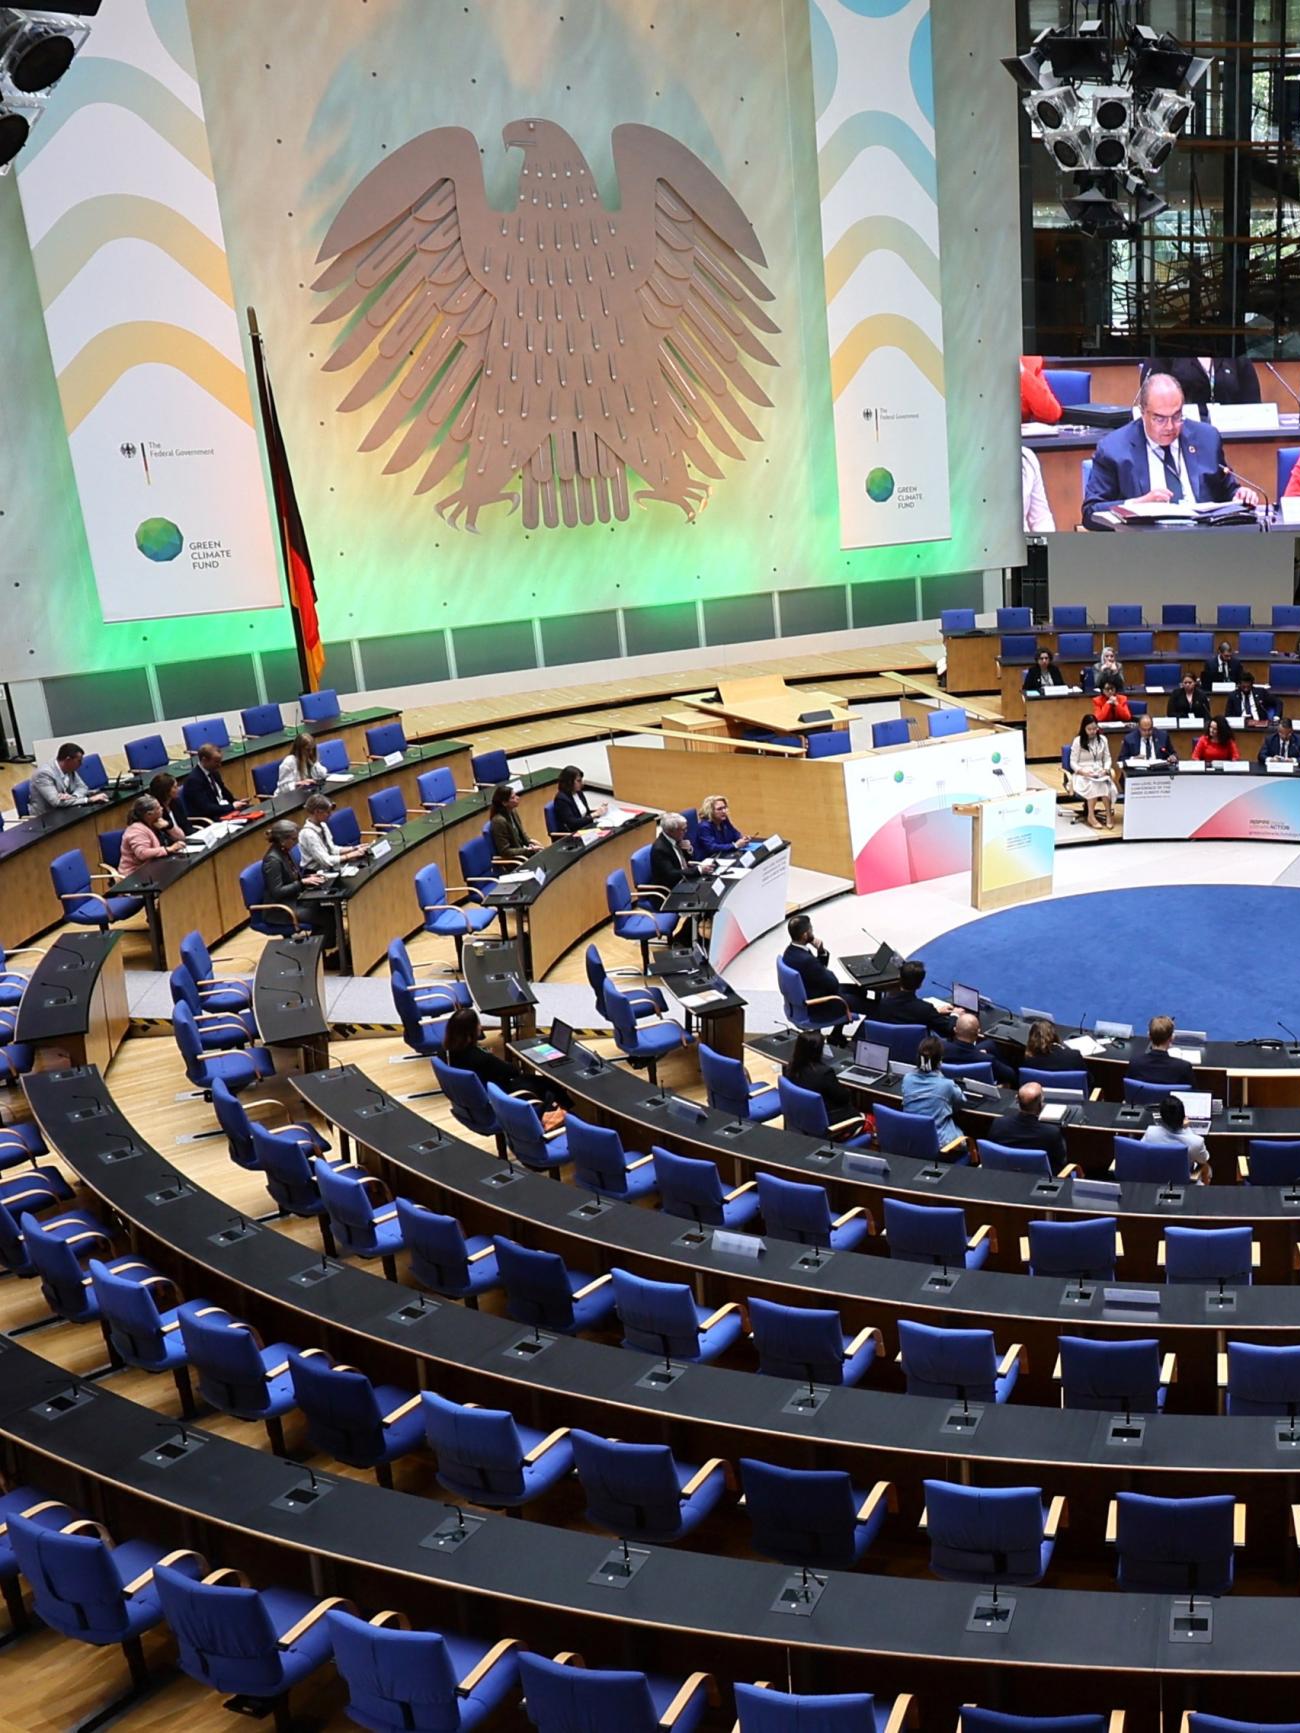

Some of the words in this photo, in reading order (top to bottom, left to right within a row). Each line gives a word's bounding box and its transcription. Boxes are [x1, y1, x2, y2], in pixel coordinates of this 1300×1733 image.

[150, 449, 174, 457] Federal
[175, 448, 214, 457] Government
[897, 486, 917, 494] GREEN
[897, 493, 922, 501] CLIMATE
[189, 541, 221, 550] GREEN
[190, 550, 232, 560] CLIMATE
[192, 561, 220, 570] FUND
